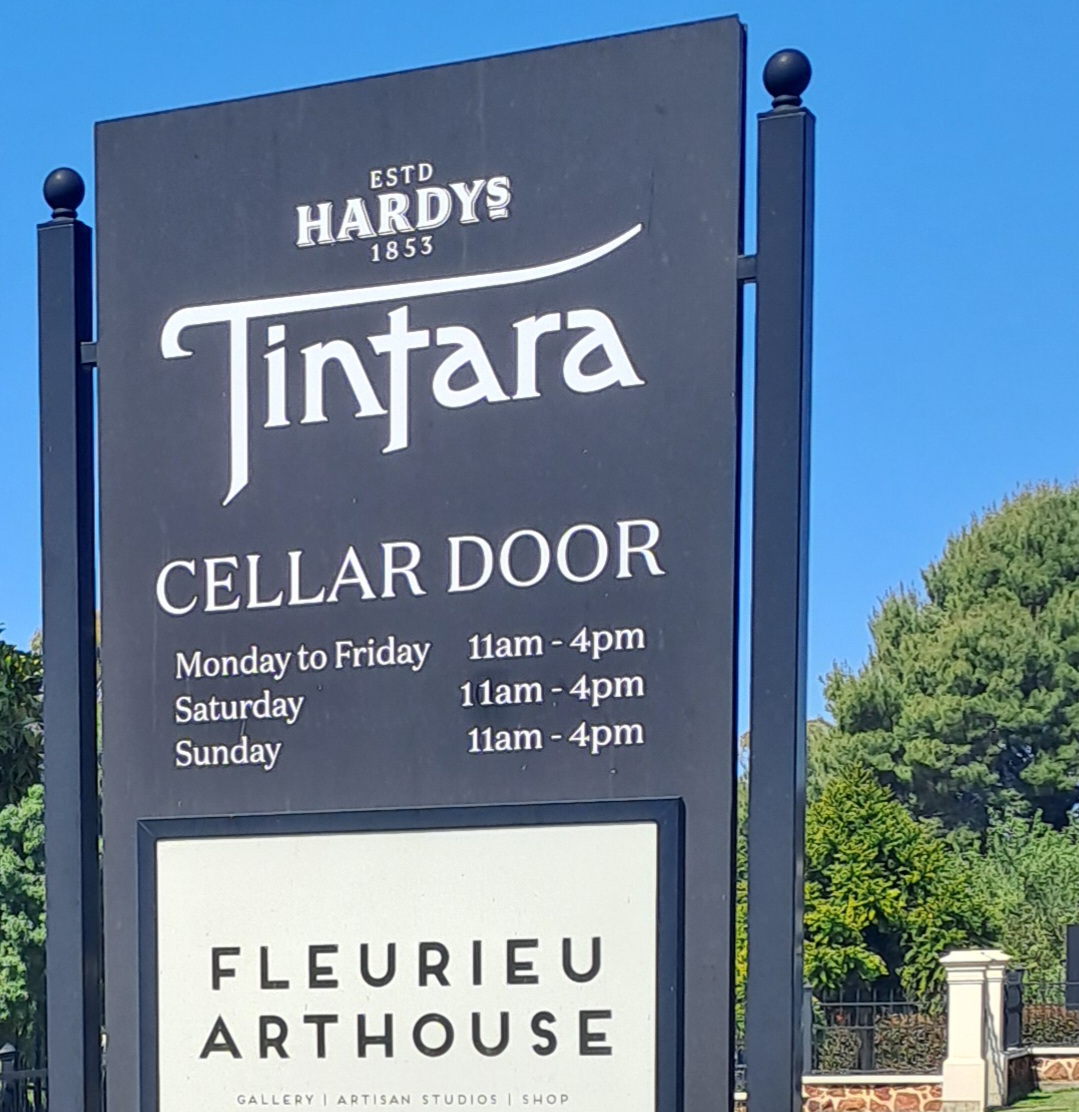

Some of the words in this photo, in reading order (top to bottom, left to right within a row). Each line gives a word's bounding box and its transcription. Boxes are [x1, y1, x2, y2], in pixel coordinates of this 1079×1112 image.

[370, 162, 434, 189] ESTD
[370, 235, 434, 263] 1853
[160, 222, 645, 507] Tintara
[156, 541, 427, 615] CELLAR
[447, 519, 665, 593] DOOR
[175, 645, 292, 681] Monday
[297, 645, 328, 672] to
[335, 635, 431, 673] Friday
[468, 633, 543, 661] 11am
[569, 626, 646, 660] 4pm
[175, 688, 305, 725] Saturday
[460, 680, 543, 707] 11am
[569, 673, 645, 707] 4pm
[175, 734, 282, 771] Sunday
[468, 727, 543, 754] 11am
[568, 721, 645, 755] 4pm
[211, 936, 602, 991] FLEURIEU
[199, 1009, 613, 1059] ARTHOUSE
[237, 1094, 315, 1106] GALLERY
[337, 1094, 411, 1106] ARTISAN
[422, 1094, 498, 1106] STUDIOS
[522, 1093, 570, 1106] SHOP
